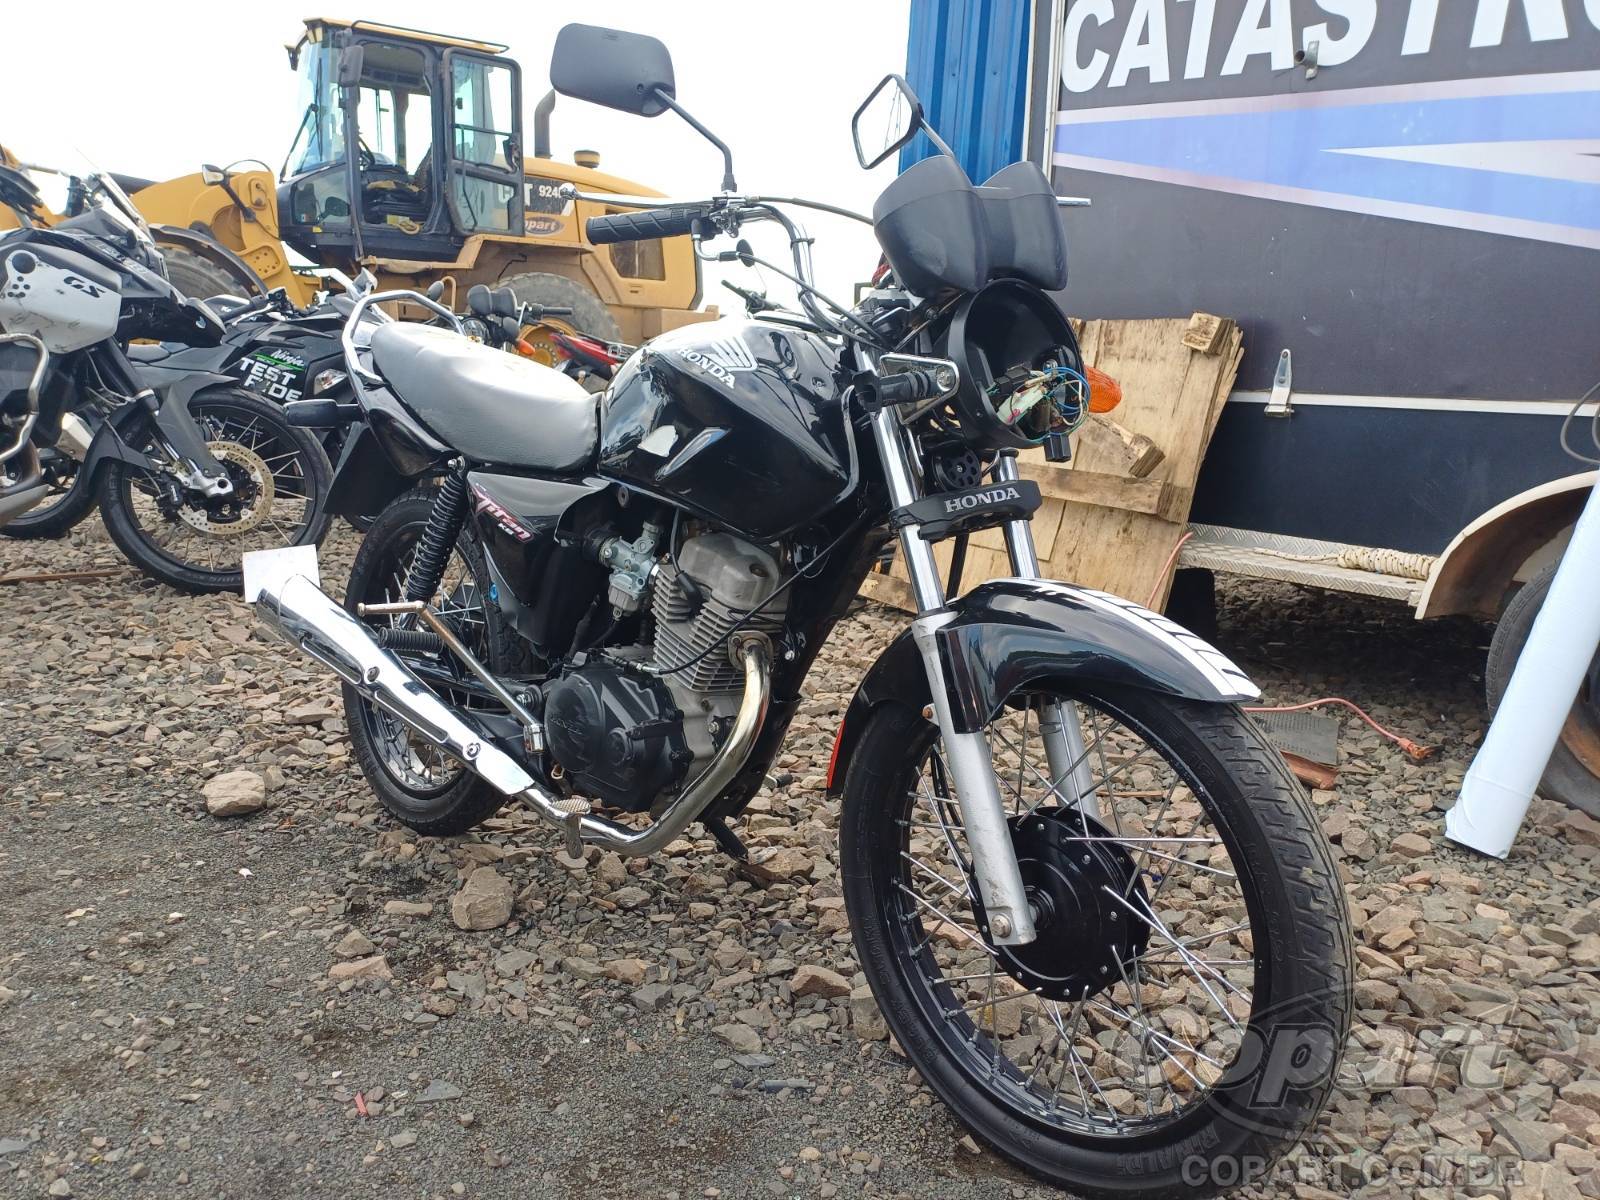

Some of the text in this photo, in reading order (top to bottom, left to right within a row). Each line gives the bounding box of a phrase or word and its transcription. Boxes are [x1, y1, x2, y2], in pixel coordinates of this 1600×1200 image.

[1061, 0, 1600, 93] CATAST
[538, 185, 562, 199] 924
[525, 219, 558, 232] part
[63, 276, 106, 298] GS
[239, 357, 297, 385] TEST
[677, 348, 735, 389] HONDA
[944, 487, 1021, 513] HONDA
